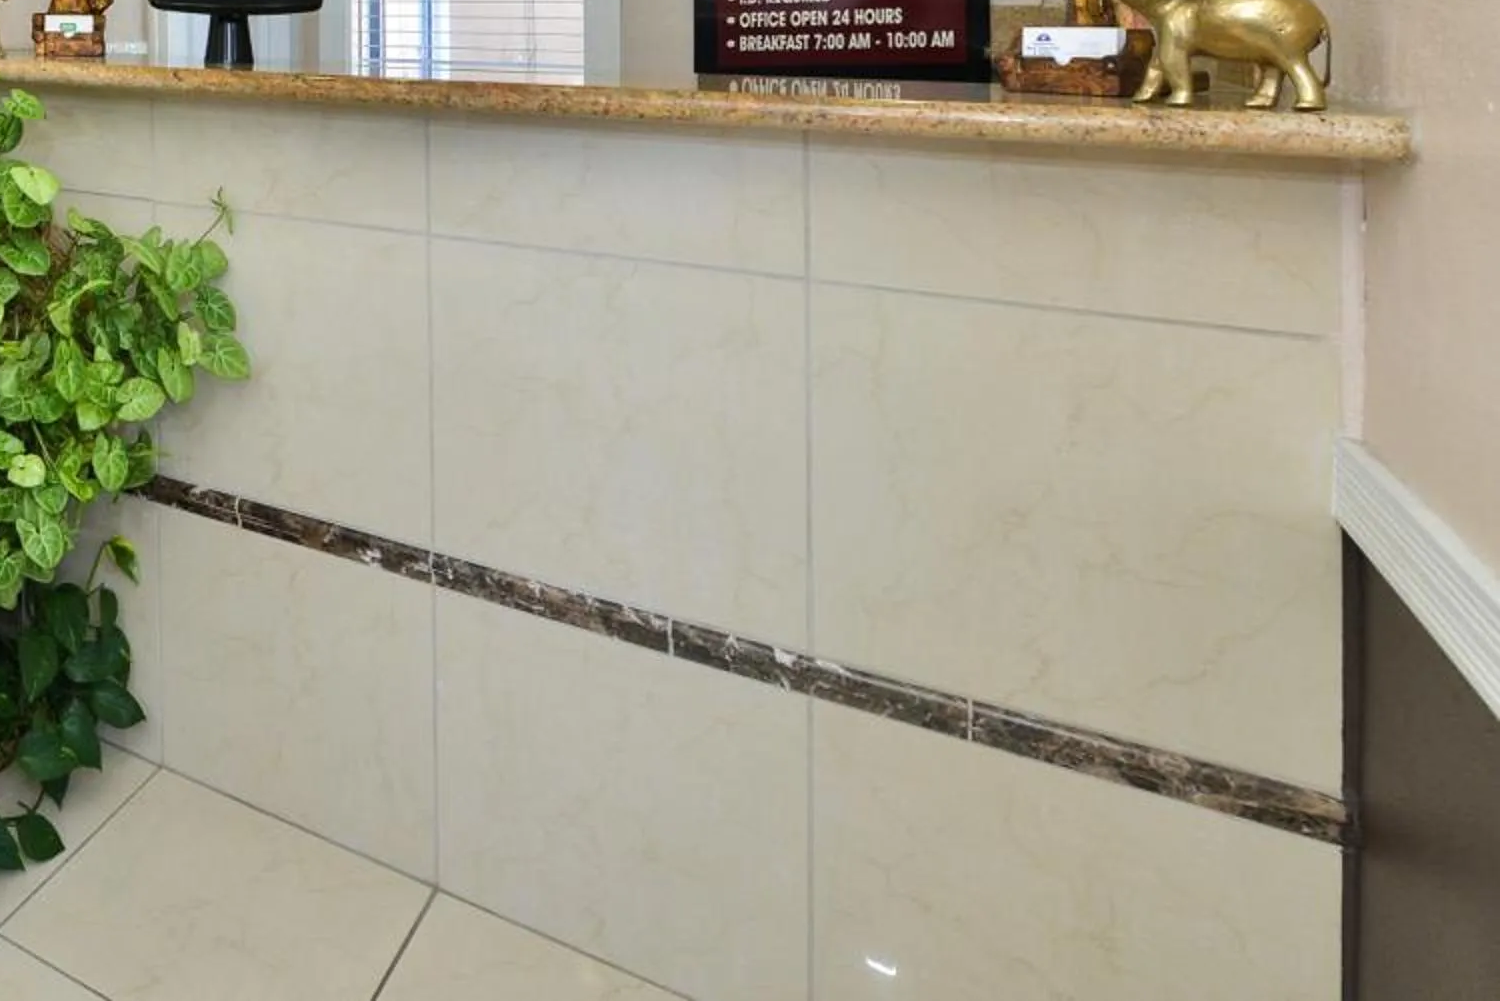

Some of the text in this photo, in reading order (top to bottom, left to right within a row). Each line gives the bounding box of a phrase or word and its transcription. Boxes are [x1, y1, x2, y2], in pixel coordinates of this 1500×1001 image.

[739, 7, 903, 28] OFFICE OPEN 24 HOURS
[739, 33, 810, 52] BREAKFAST
[813, 32, 845, 51] 7:00
[847, 32, 871, 50] AM
[886, 30, 927, 49] 10:00
[930, 30, 955, 48] AM
